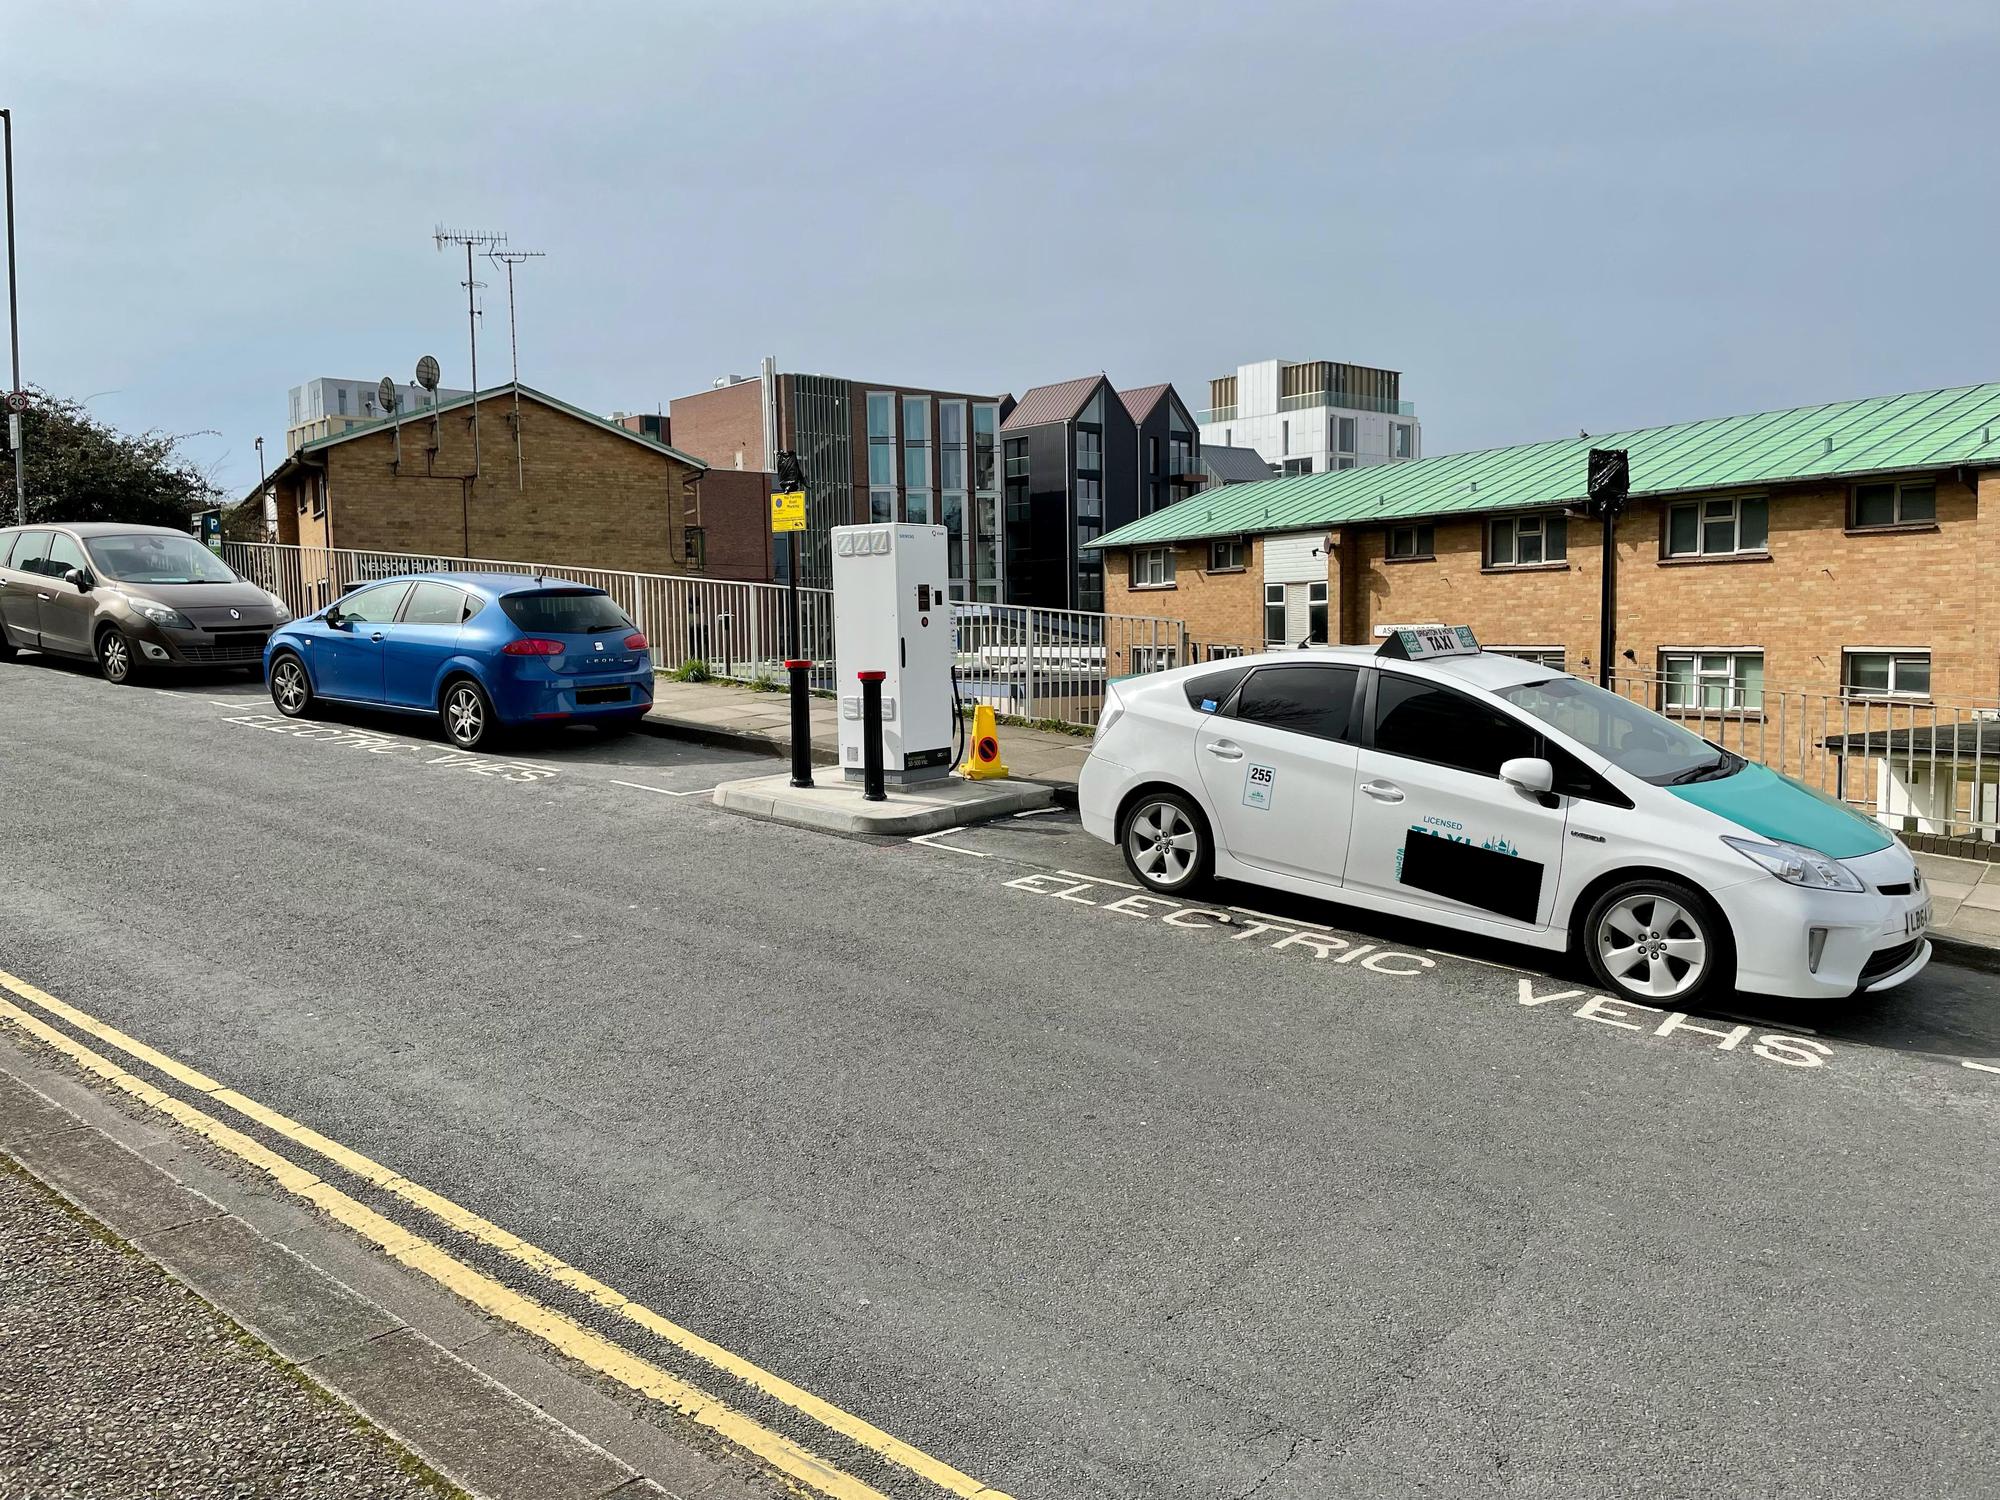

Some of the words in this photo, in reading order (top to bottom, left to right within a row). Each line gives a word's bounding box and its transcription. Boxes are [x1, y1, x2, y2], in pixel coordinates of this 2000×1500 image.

[10, 397, 25, 406] 20
[210, 518, 218, 530] P
[360, 562, 408, 573] NELSON
[1401, 632, 1417, 641] FOR
[1456, 628, 1471, 637] FOR
[1406, 641, 1422, 651] HIRE
[1427, 635, 1454, 651] TAXI
[221, 715, 420, 754] ELECTRIC
[1251, 767, 1272, 783] 255
[1423, 816, 1463, 831] LICENSED
[1001, 873, 1437, 976] ELECTRIC
[1517, 978, 1834, 1068] VEHS
